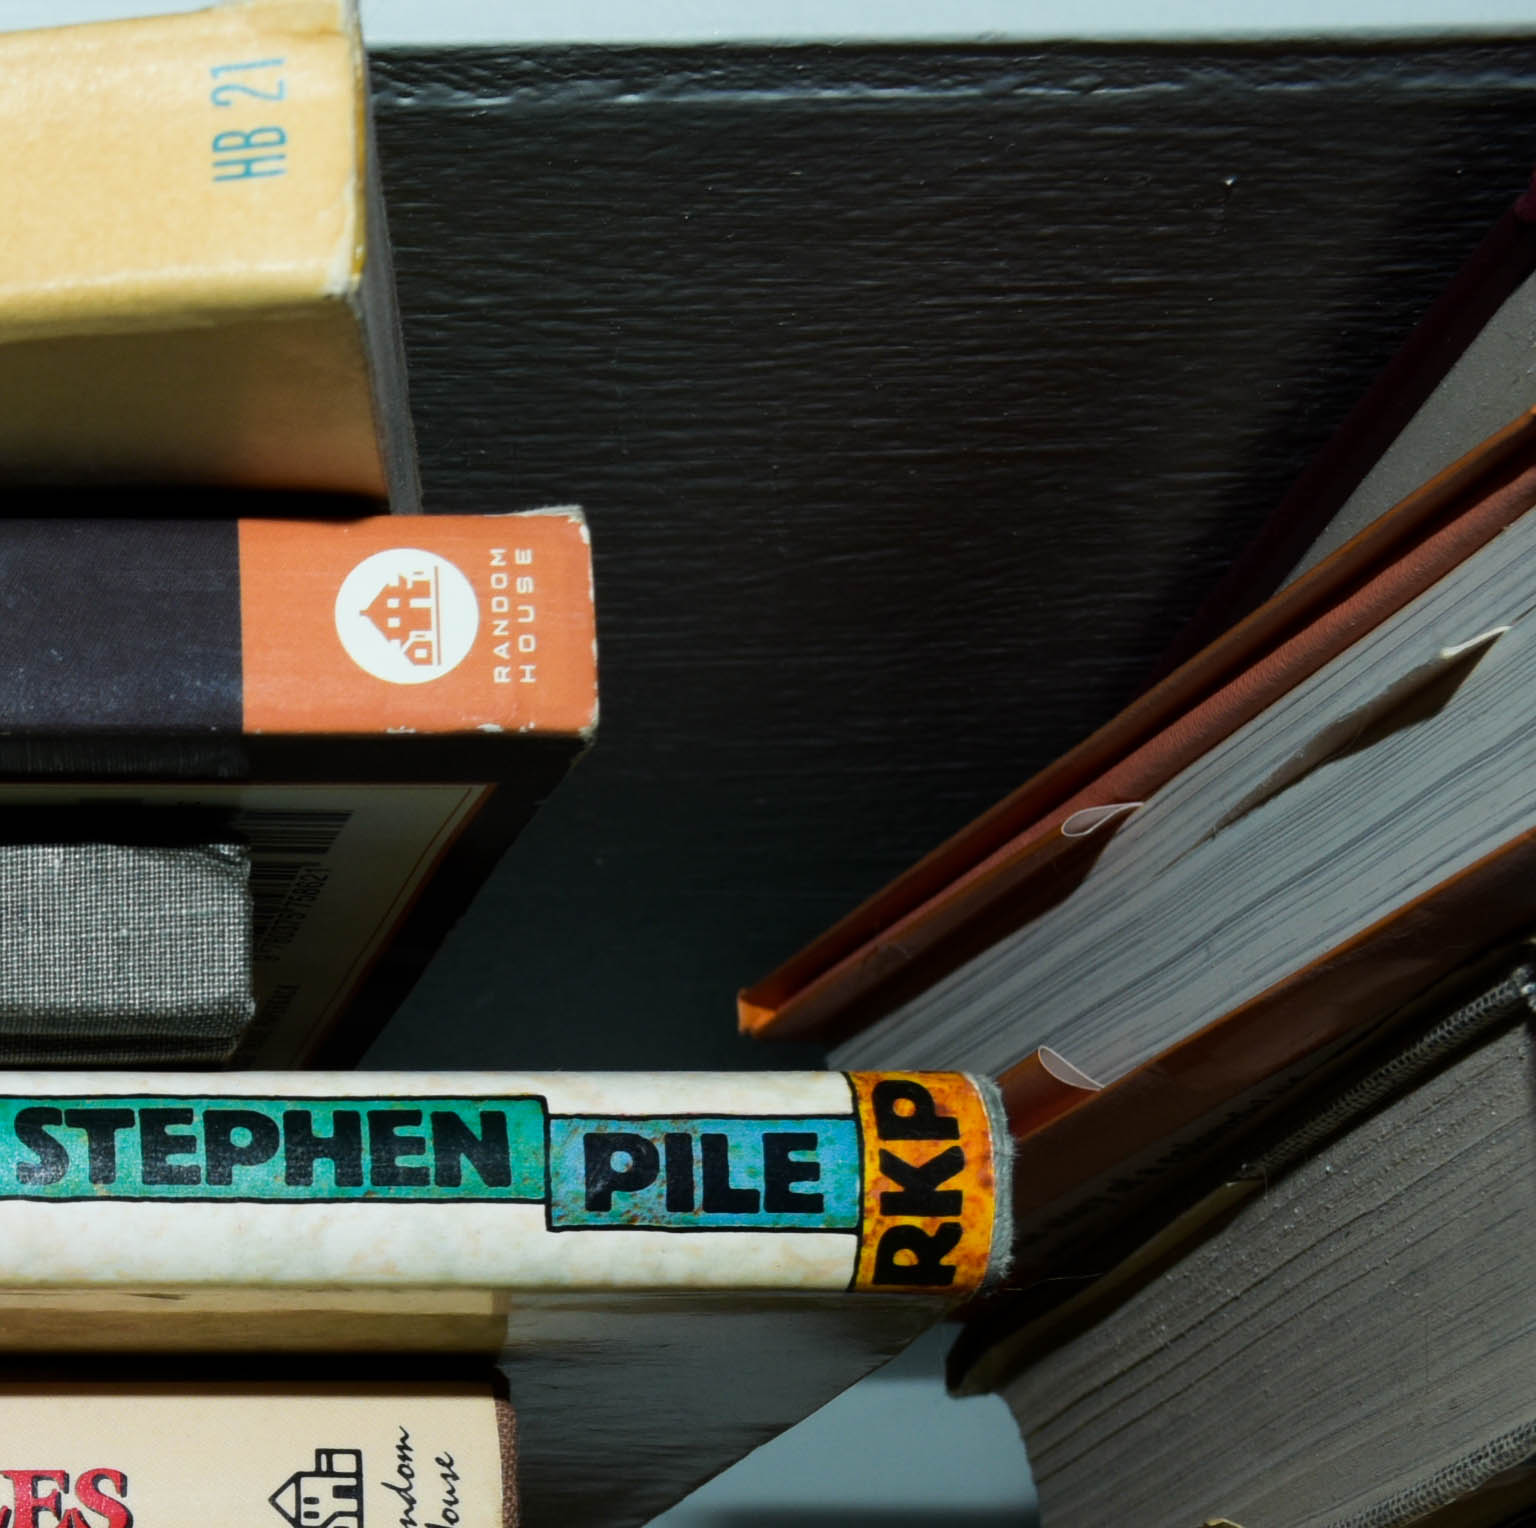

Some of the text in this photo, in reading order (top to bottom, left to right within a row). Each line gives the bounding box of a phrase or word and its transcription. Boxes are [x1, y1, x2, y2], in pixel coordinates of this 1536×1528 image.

[211, 56, 287, 183] HB 21
[491, 547, 509, 684] RANDOM
[514, 547, 533, 684] HOUSE
[14, 1107, 822, 1214] STEPHEN PILE
[873, 1079, 963, 1288] RKP
